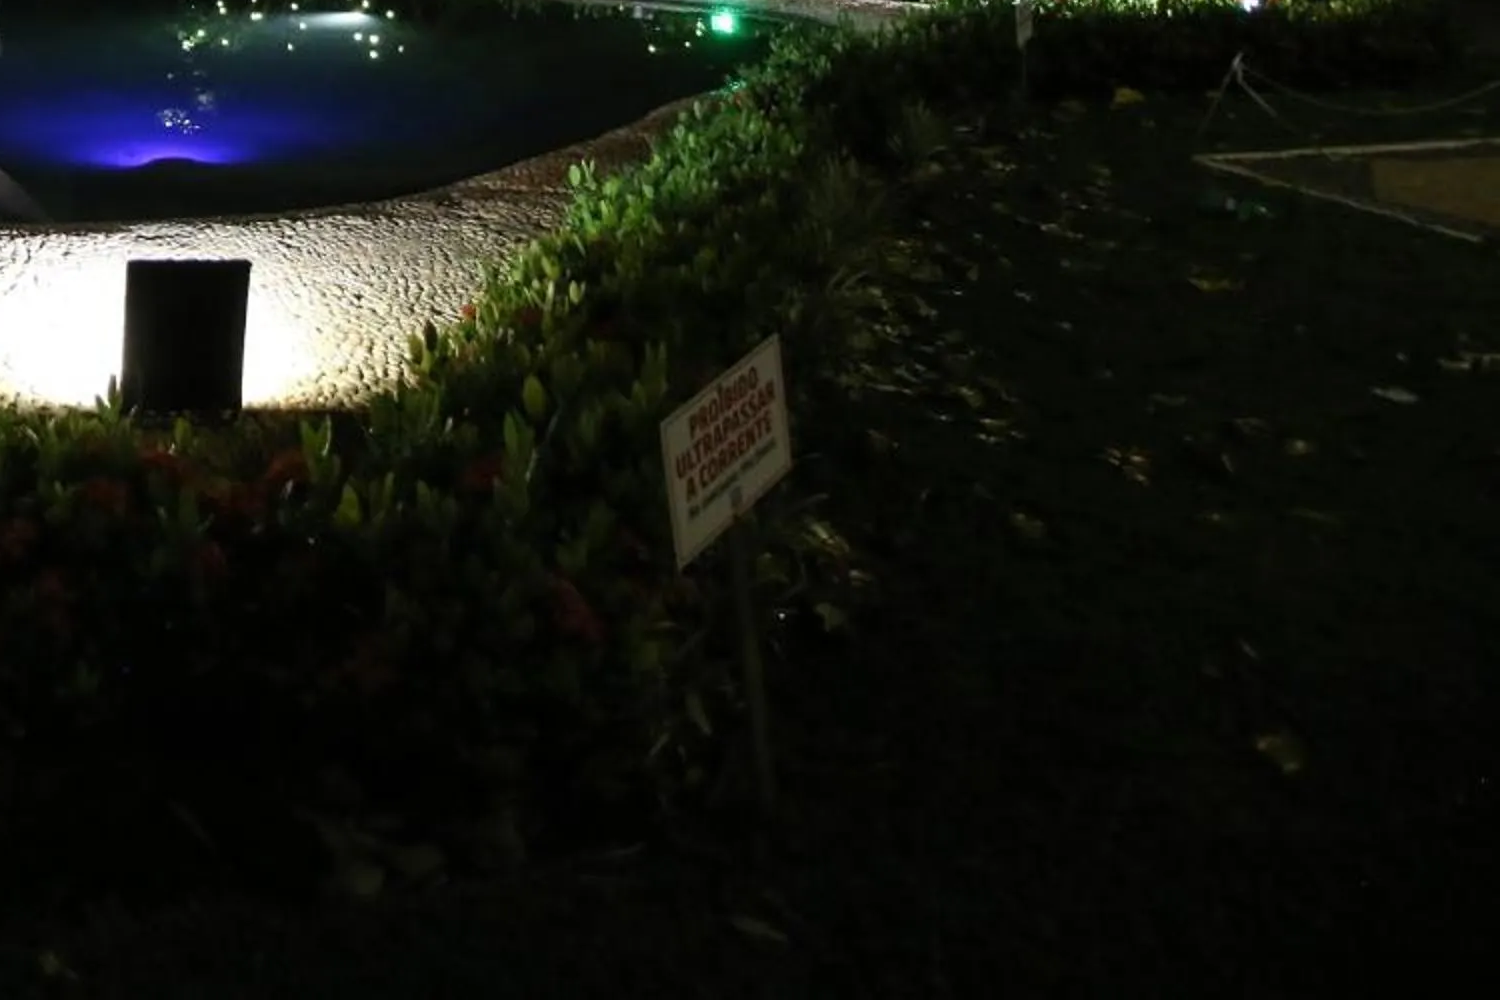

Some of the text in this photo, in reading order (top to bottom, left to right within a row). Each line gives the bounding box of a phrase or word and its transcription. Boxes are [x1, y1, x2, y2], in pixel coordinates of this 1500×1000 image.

[676, 379, 775, 479] ULTRAPASSAR
[686, 476, 697, 503] A
[699, 410, 772, 488] CORRENTE
